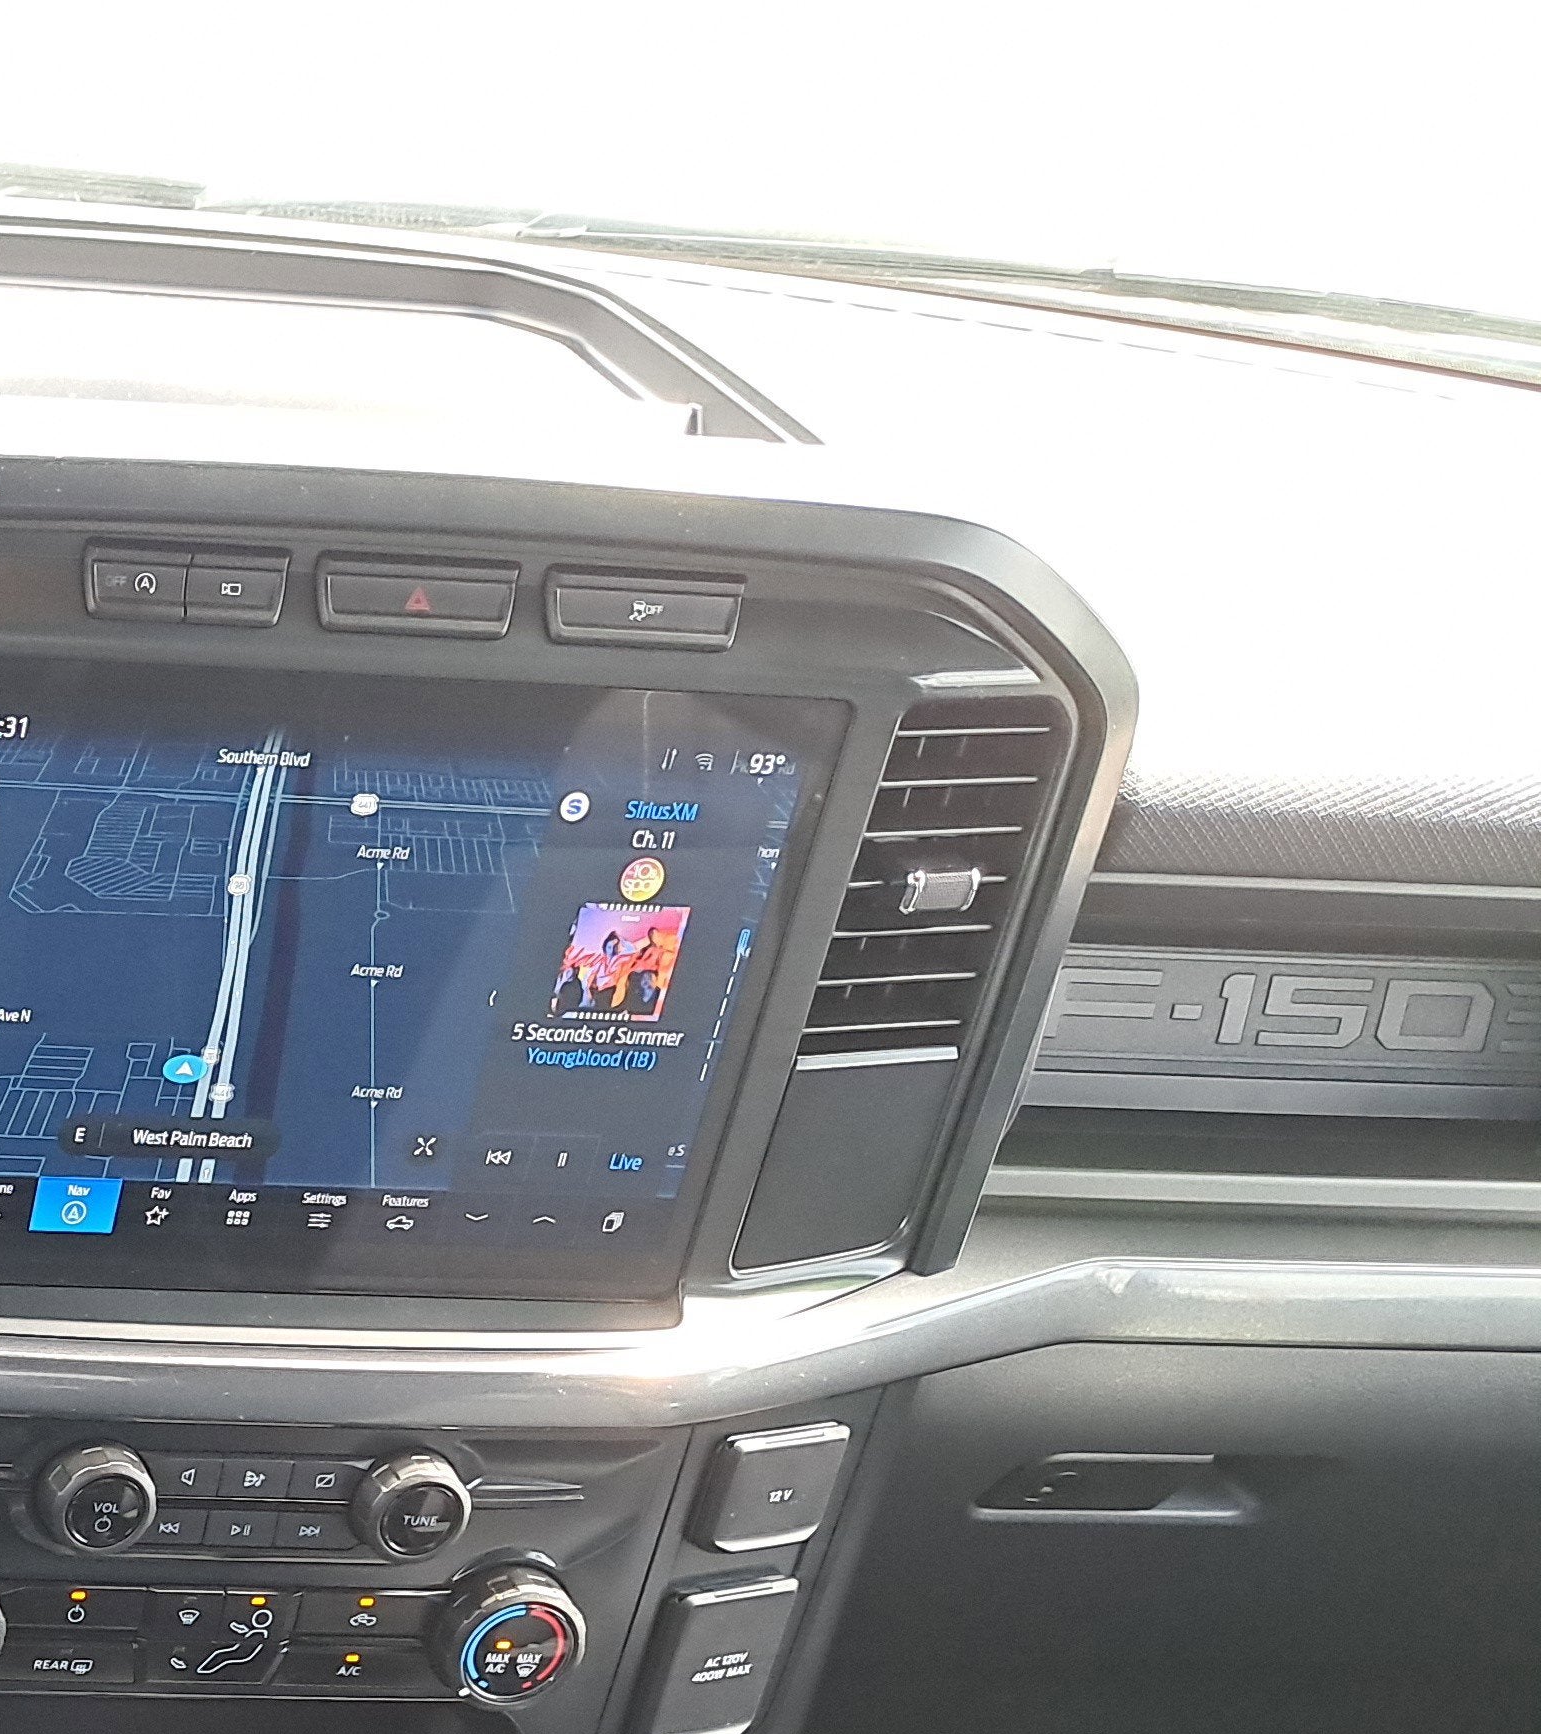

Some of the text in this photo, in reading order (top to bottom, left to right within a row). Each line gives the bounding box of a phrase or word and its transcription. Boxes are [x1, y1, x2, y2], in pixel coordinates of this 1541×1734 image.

[280, 751, 311, 768] Blvd
[625, 800, 699, 821] SiriusXM
[632, 830, 676, 850] Ch. 11
[357, 845, 410, 861] Acme Rd
[350, 963, 404, 979] Acme Rd
[21, 1009, 32, 1023] N
[512, 1023, 684, 1047] 5 Seconds of Summer
[528, 1048, 657, 1071] Youngblood (18)
[351, 1085, 403, 1100] Acme Rd
[75, 1127, 252, 1149] E West Palm Beach
[610, 1153, 643, 1171] Live
[68, 1185, 91, 1196] Nav
[151, 1187, 172, 1199] Fav
[229, 1189, 257, 1203] Apps
[302, 1192, 347, 1207] Settings
[382, 1195, 430, 1208] Features
[93, 1502, 119, 1514] VOL
[403, 1514, 439, 1527] TUNE
[33, 1659, 69, 1671] REAR
[485, 1654, 510, 1664] MAX
[517, 1654, 543, 1664] MAX
[336, 1666, 362, 1677] A/C
[485, 1664, 506, 1674] A/C
[726, 1663, 753, 1678] MAX
